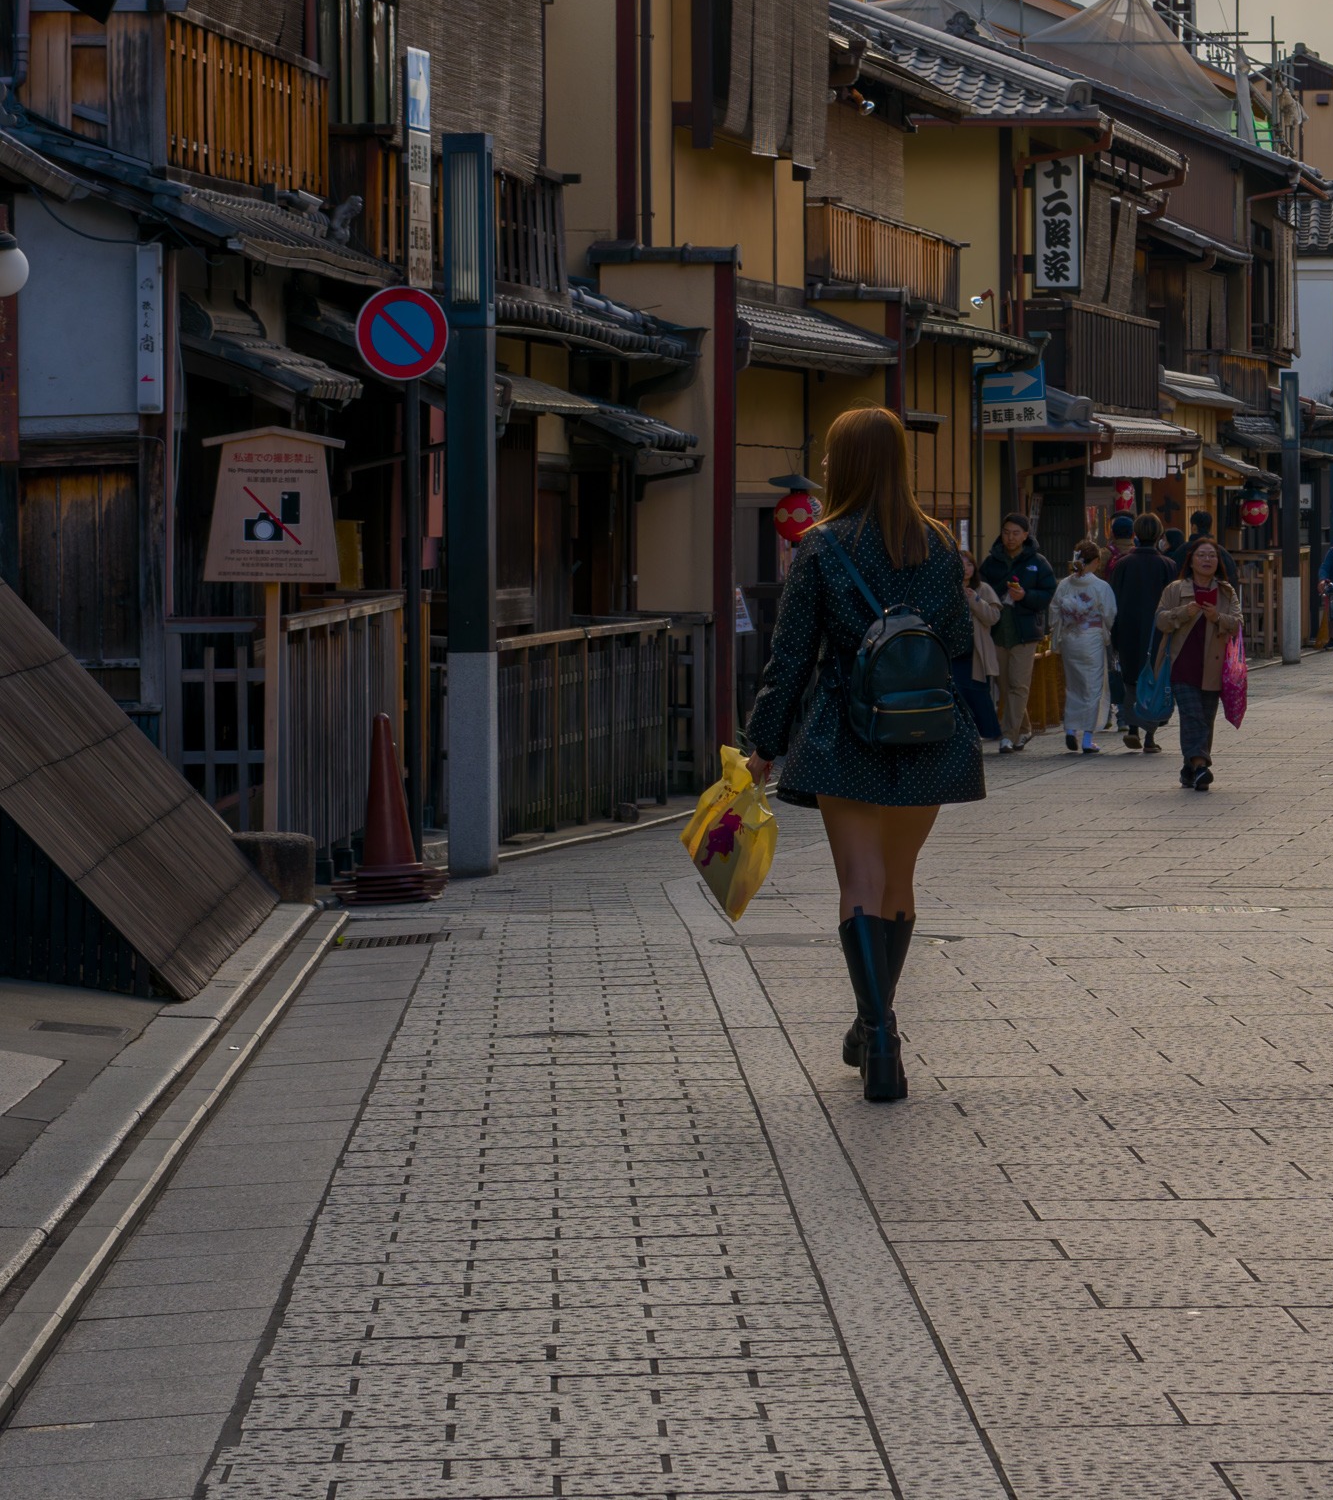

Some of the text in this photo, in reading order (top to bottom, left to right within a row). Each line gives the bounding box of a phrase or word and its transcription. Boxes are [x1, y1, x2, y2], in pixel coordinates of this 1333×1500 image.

[983, 406, 1043, 424] 自転車を除く
[233, 452, 314, 463] 私道での撮影禁止
